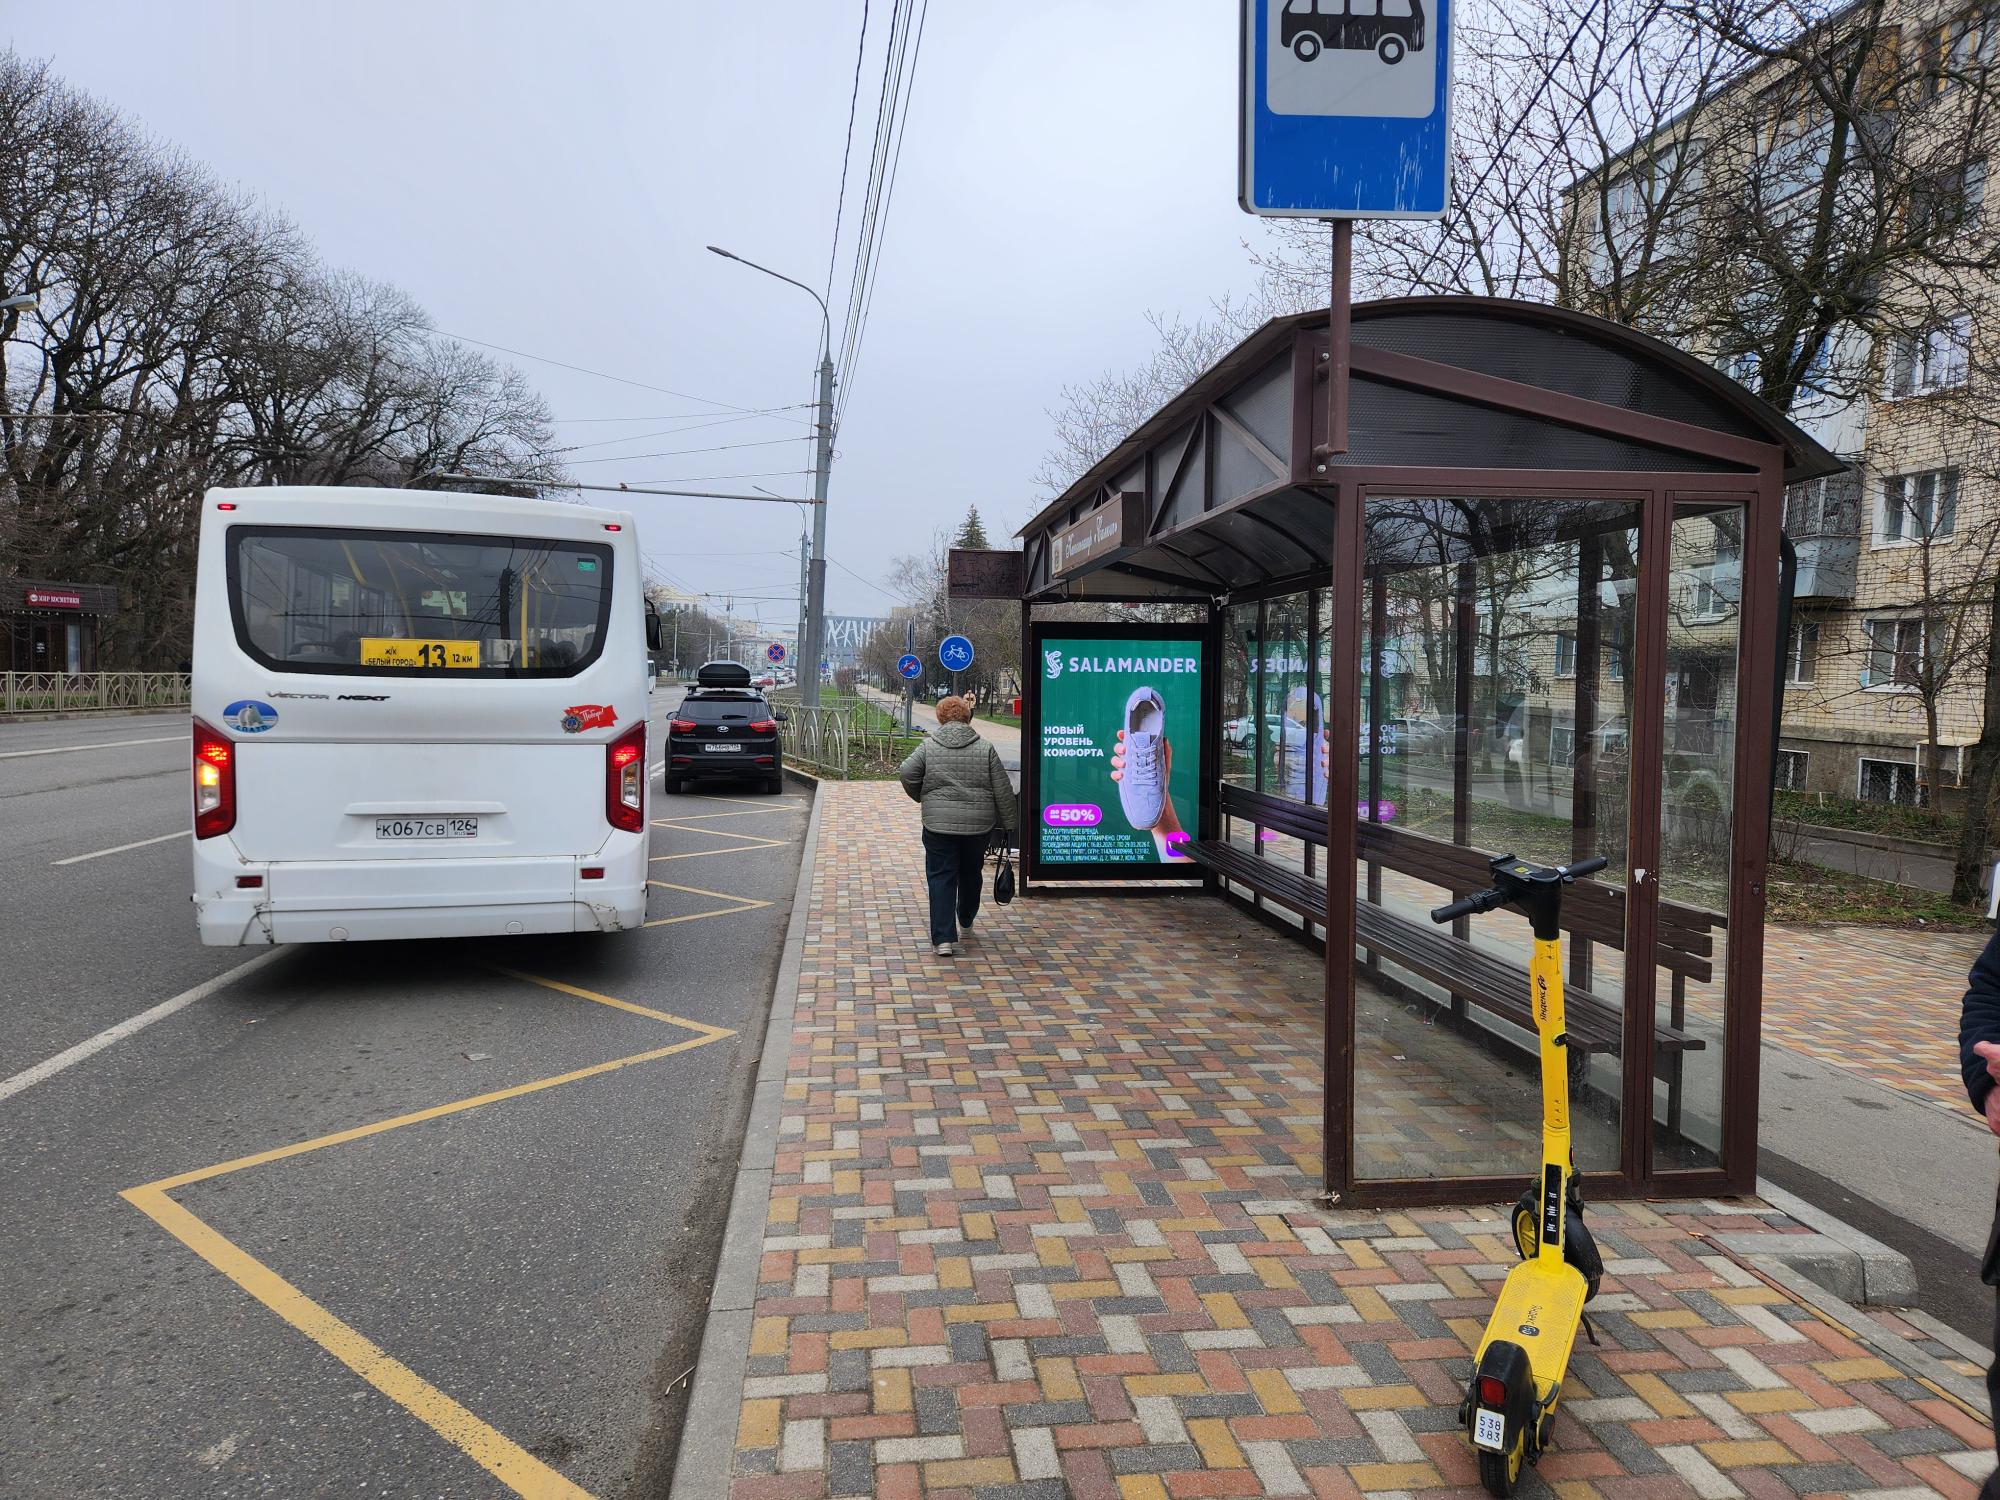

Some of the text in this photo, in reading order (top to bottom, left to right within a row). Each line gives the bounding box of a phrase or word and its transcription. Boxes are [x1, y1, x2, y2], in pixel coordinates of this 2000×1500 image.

[418, 644, 446, 668] 13
[452, 654, 460, 663] 12
[1069, 657, 1197, 673] SALAMANDER
[266, 690, 330, 700] VECTOR
[1044, 724, 1084, 735] НОВЫЙ
[1044, 738, 1093, 746] УРОВЕНЬ
[1044, 748, 1104, 758] КОМФОРТА
[382, 820, 472, 836] К067СВ 126
[1480, 1416, 1500, 1430] 538
[1479, 1428, 1500, 1442] 383
